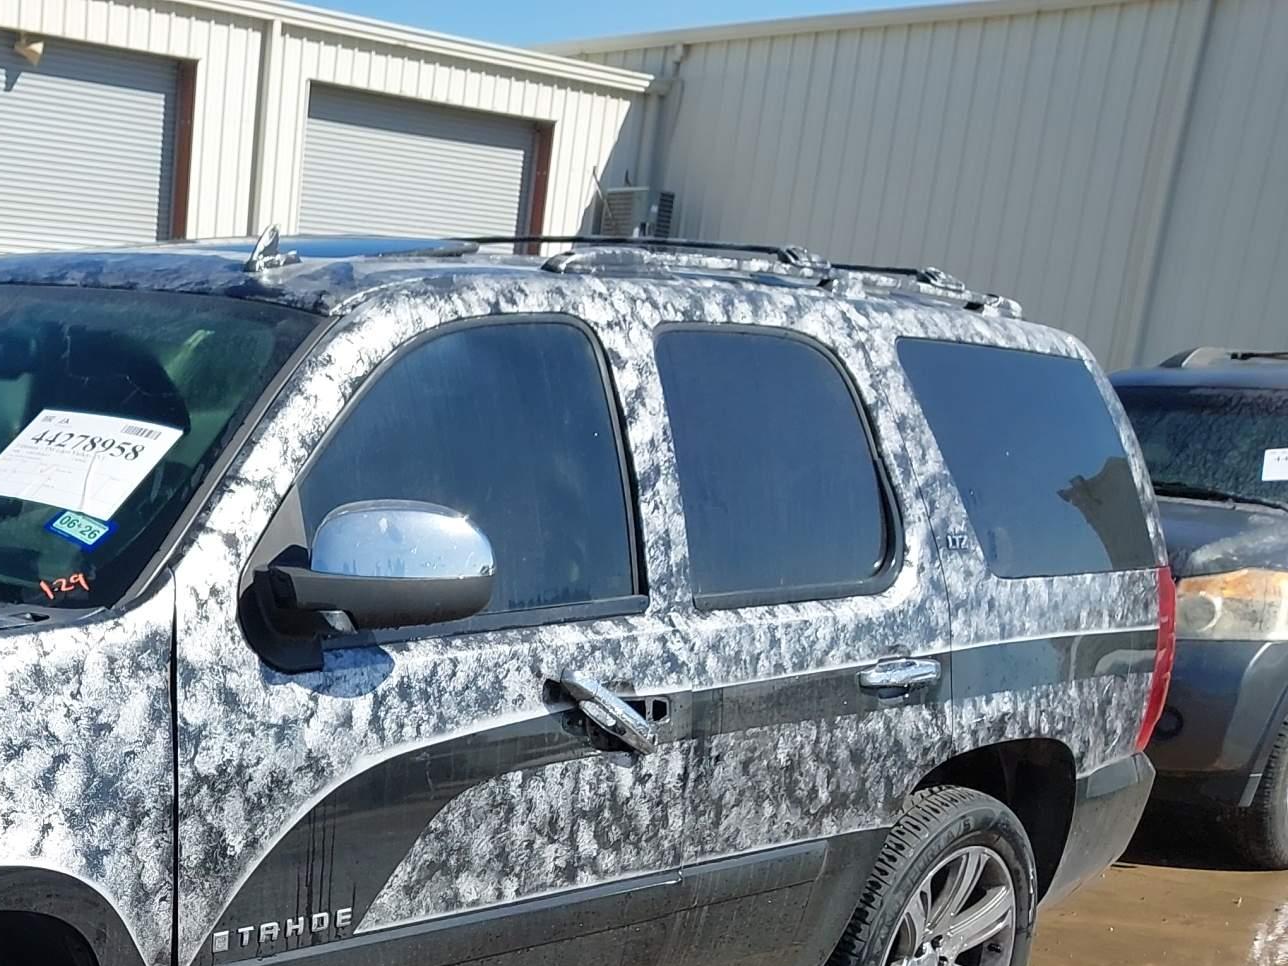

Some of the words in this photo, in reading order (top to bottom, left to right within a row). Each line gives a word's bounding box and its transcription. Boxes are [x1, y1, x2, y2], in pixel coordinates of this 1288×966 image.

[31, 429, 145, 461] 44278958
[59, 515, 80, 529] 06
[79, 524, 101, 540] 26
[237, 907, 353, 946] TAHOE
